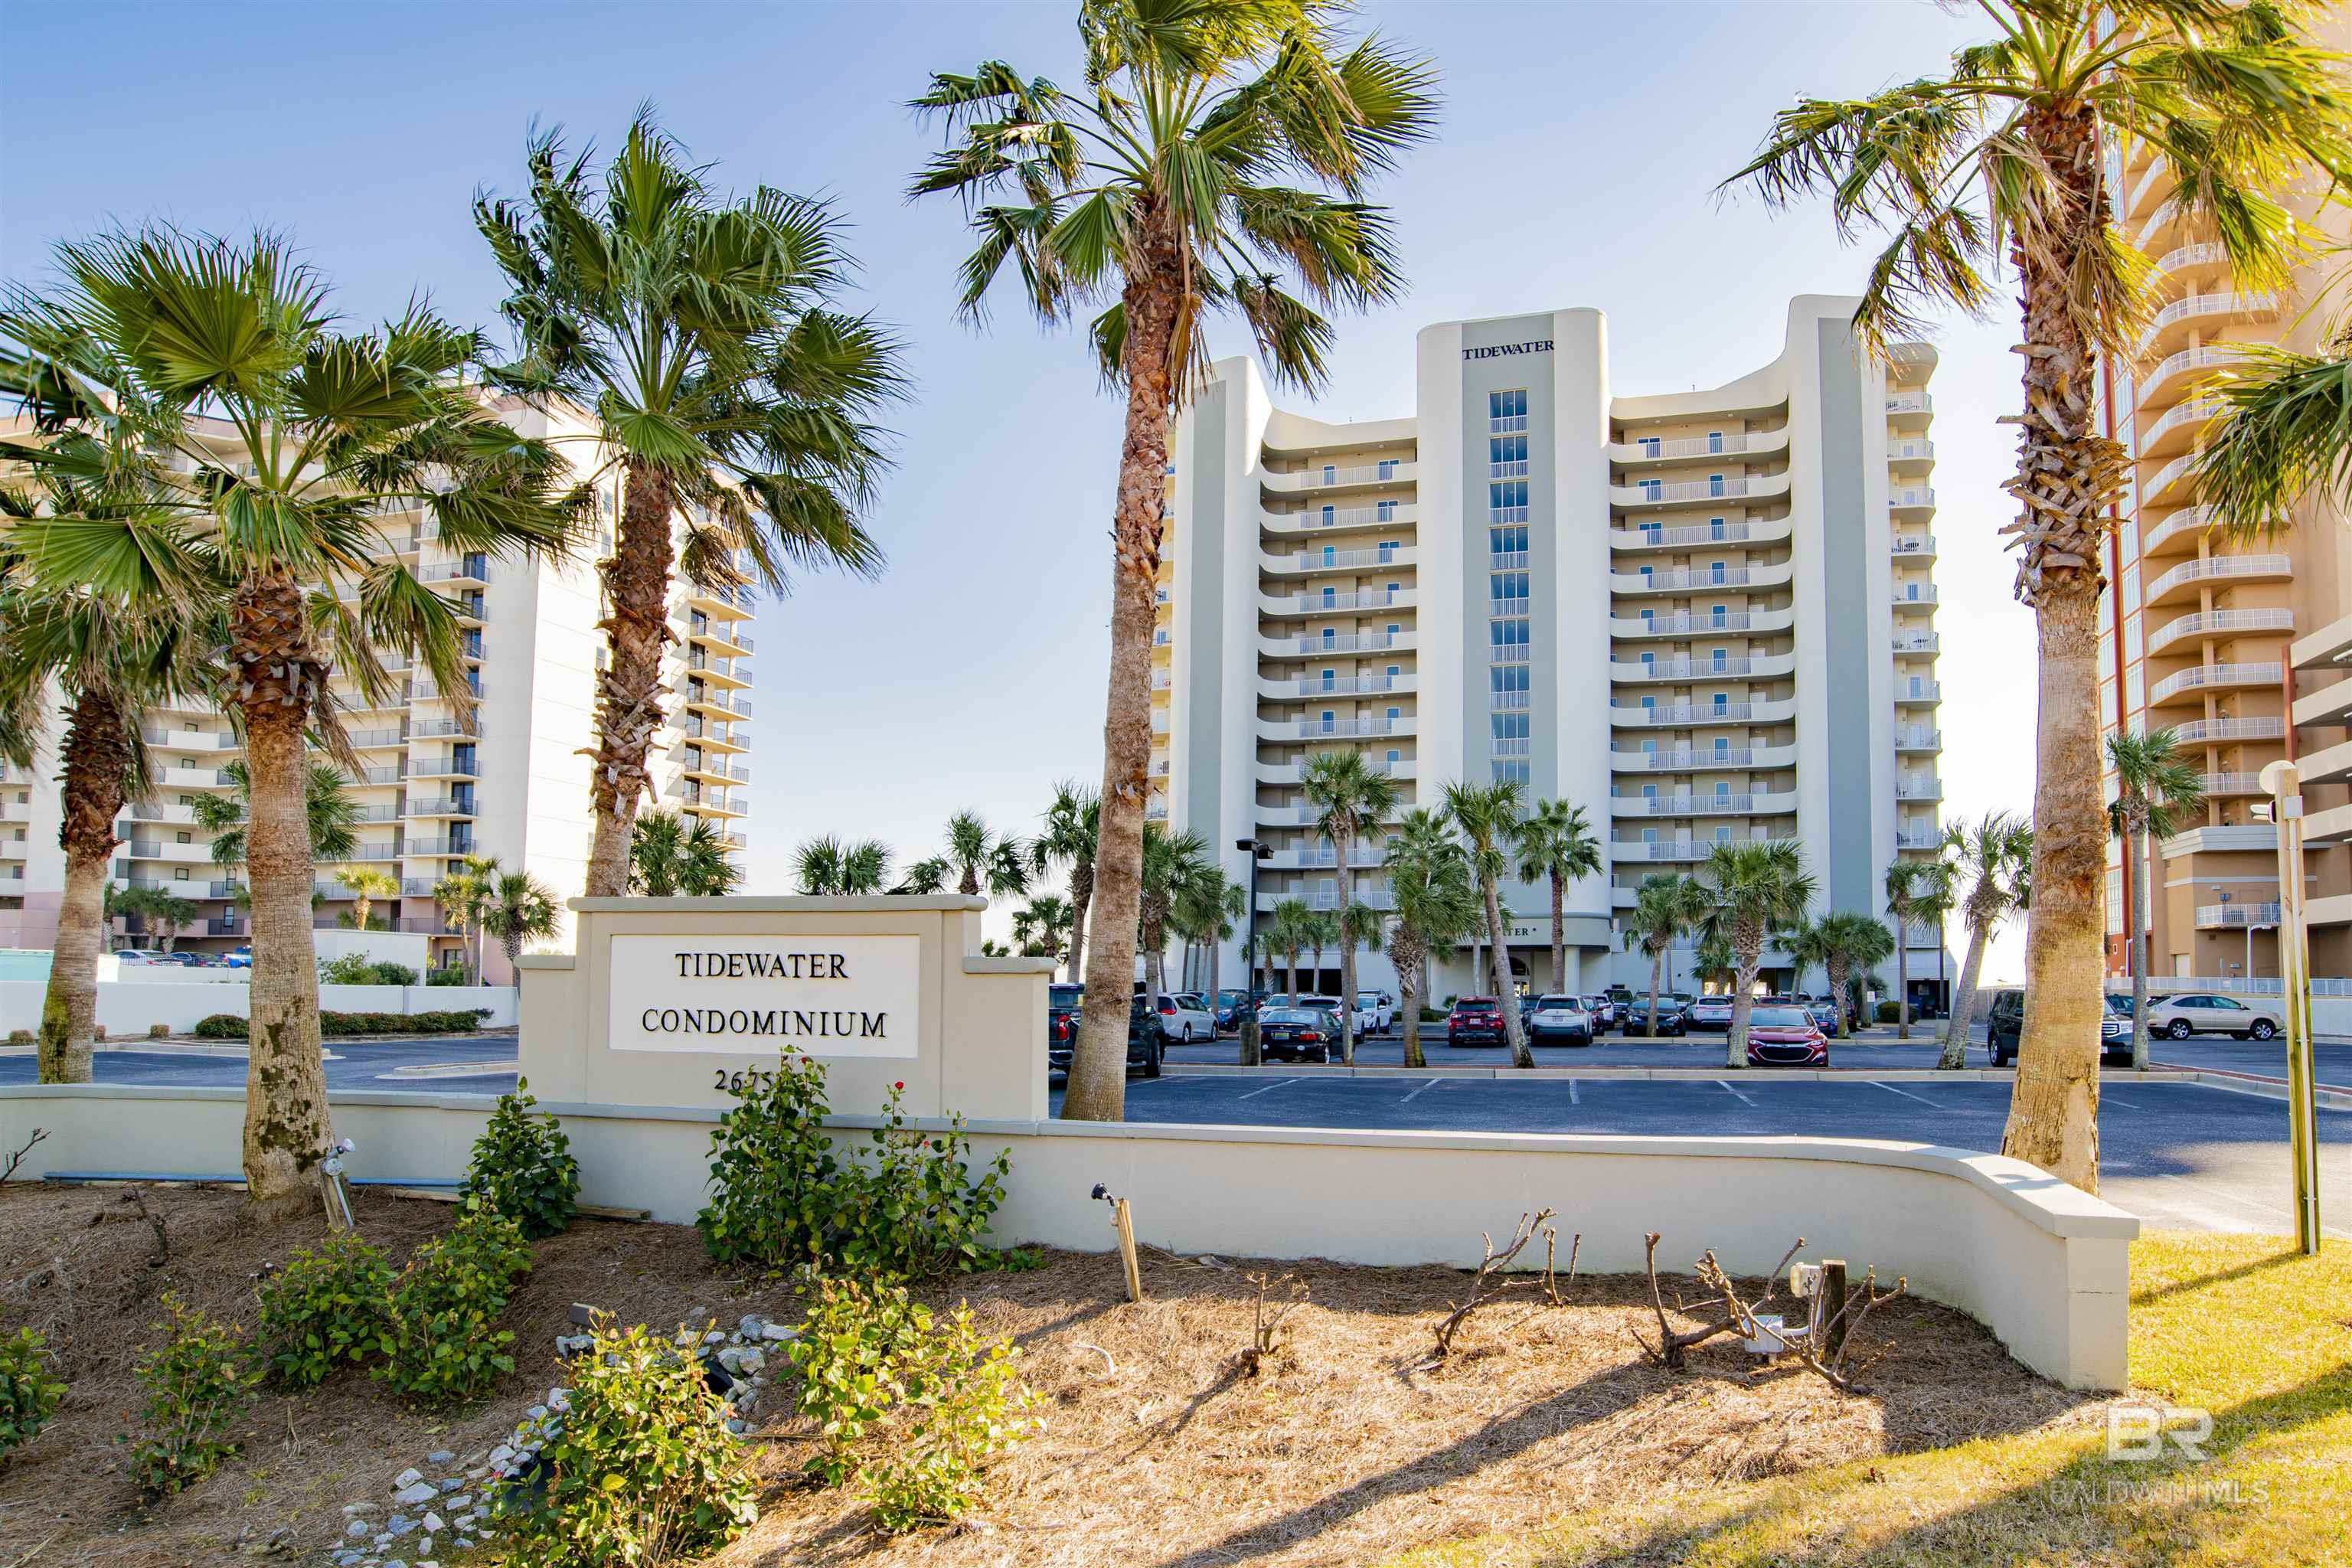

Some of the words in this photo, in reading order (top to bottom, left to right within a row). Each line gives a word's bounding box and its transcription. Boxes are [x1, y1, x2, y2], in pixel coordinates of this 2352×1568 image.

[1462, 340, 1555, 360] TIDEWATER
[675, 952, 851, 978] TIDEWATER
[642, 1008, 887, 1037] CONDOMINIUM
